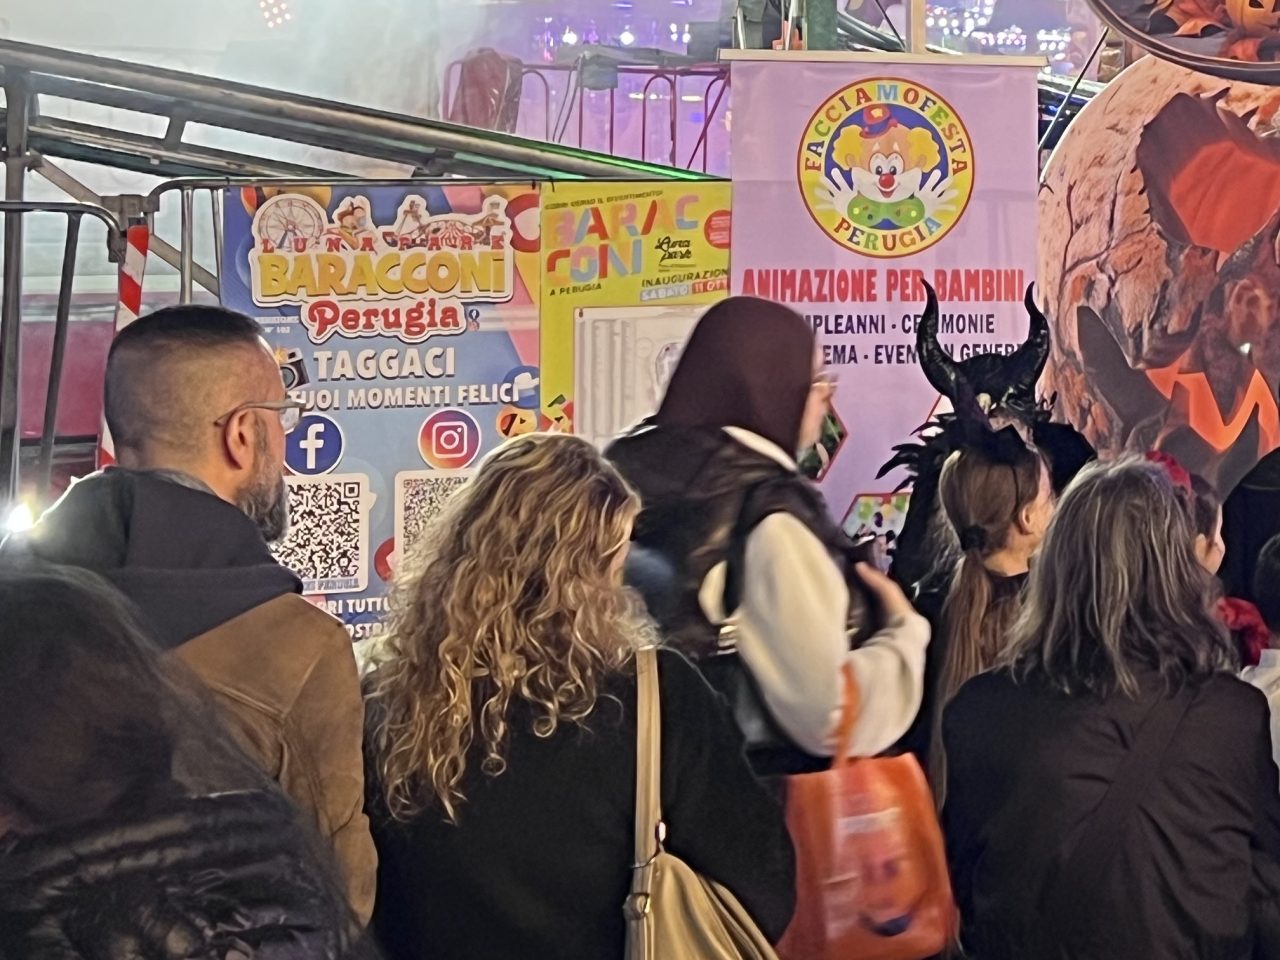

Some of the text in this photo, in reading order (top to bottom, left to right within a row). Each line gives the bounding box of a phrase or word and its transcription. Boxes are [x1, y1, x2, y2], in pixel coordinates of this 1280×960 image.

[261, 237, 376, 253] LUNA
[833, 216, 943, 253] PERUGIA
[559, 282, 602, 295] PERUGIA
[641, 268, 728, 288] INAUGURAZION
[741, 268, 1025, 303] ANIMAZIONE PER BAMBINI
[308, 299, 460, 336] Perugia
[901, 313, 995, 334] CEMONIE
[313, 346, 456, 381] TAGGACI
[822, 344, 858, 365] EMA
[875, 344, 918, 365] EVEN
[347, 385, 451, 410] MOMENTI
[457, 380, 520, 405] FELICI
